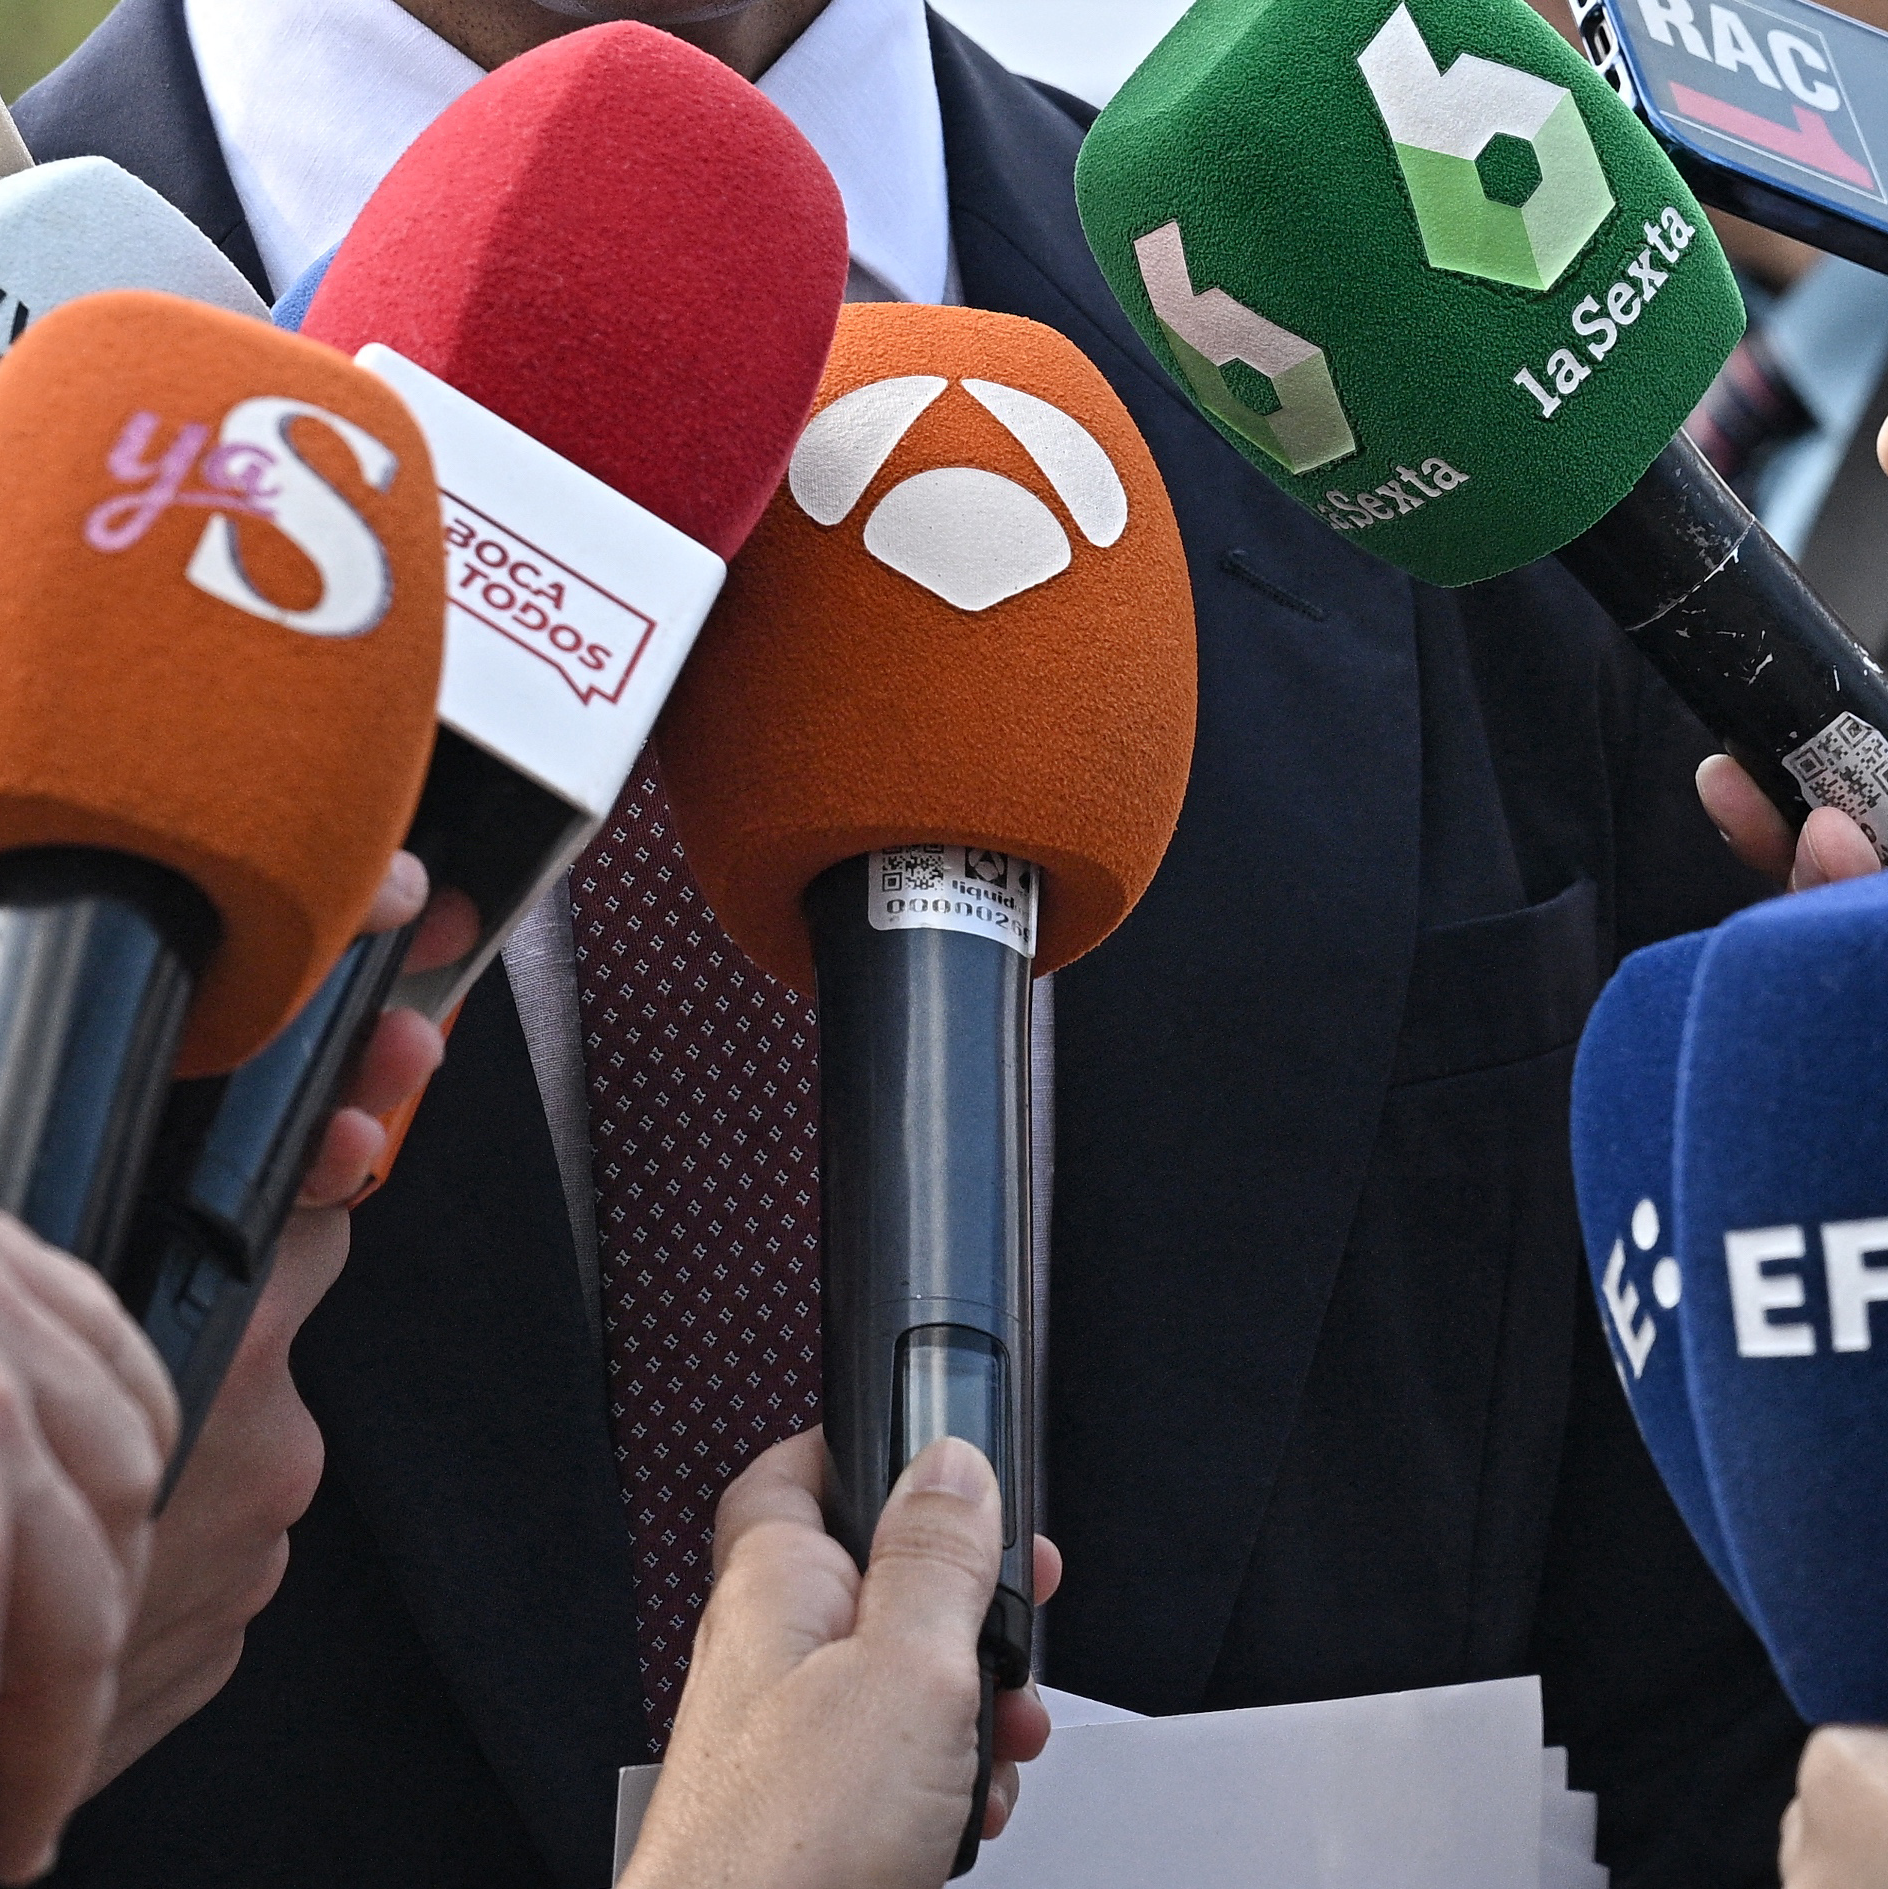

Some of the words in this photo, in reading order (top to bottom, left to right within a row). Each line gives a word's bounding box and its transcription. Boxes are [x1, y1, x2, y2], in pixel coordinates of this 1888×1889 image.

[1317, 457, 1470, 529] aSexta
[444, 517, 567, 611] BOCA
[458, 561, 614, 671] TODOS
